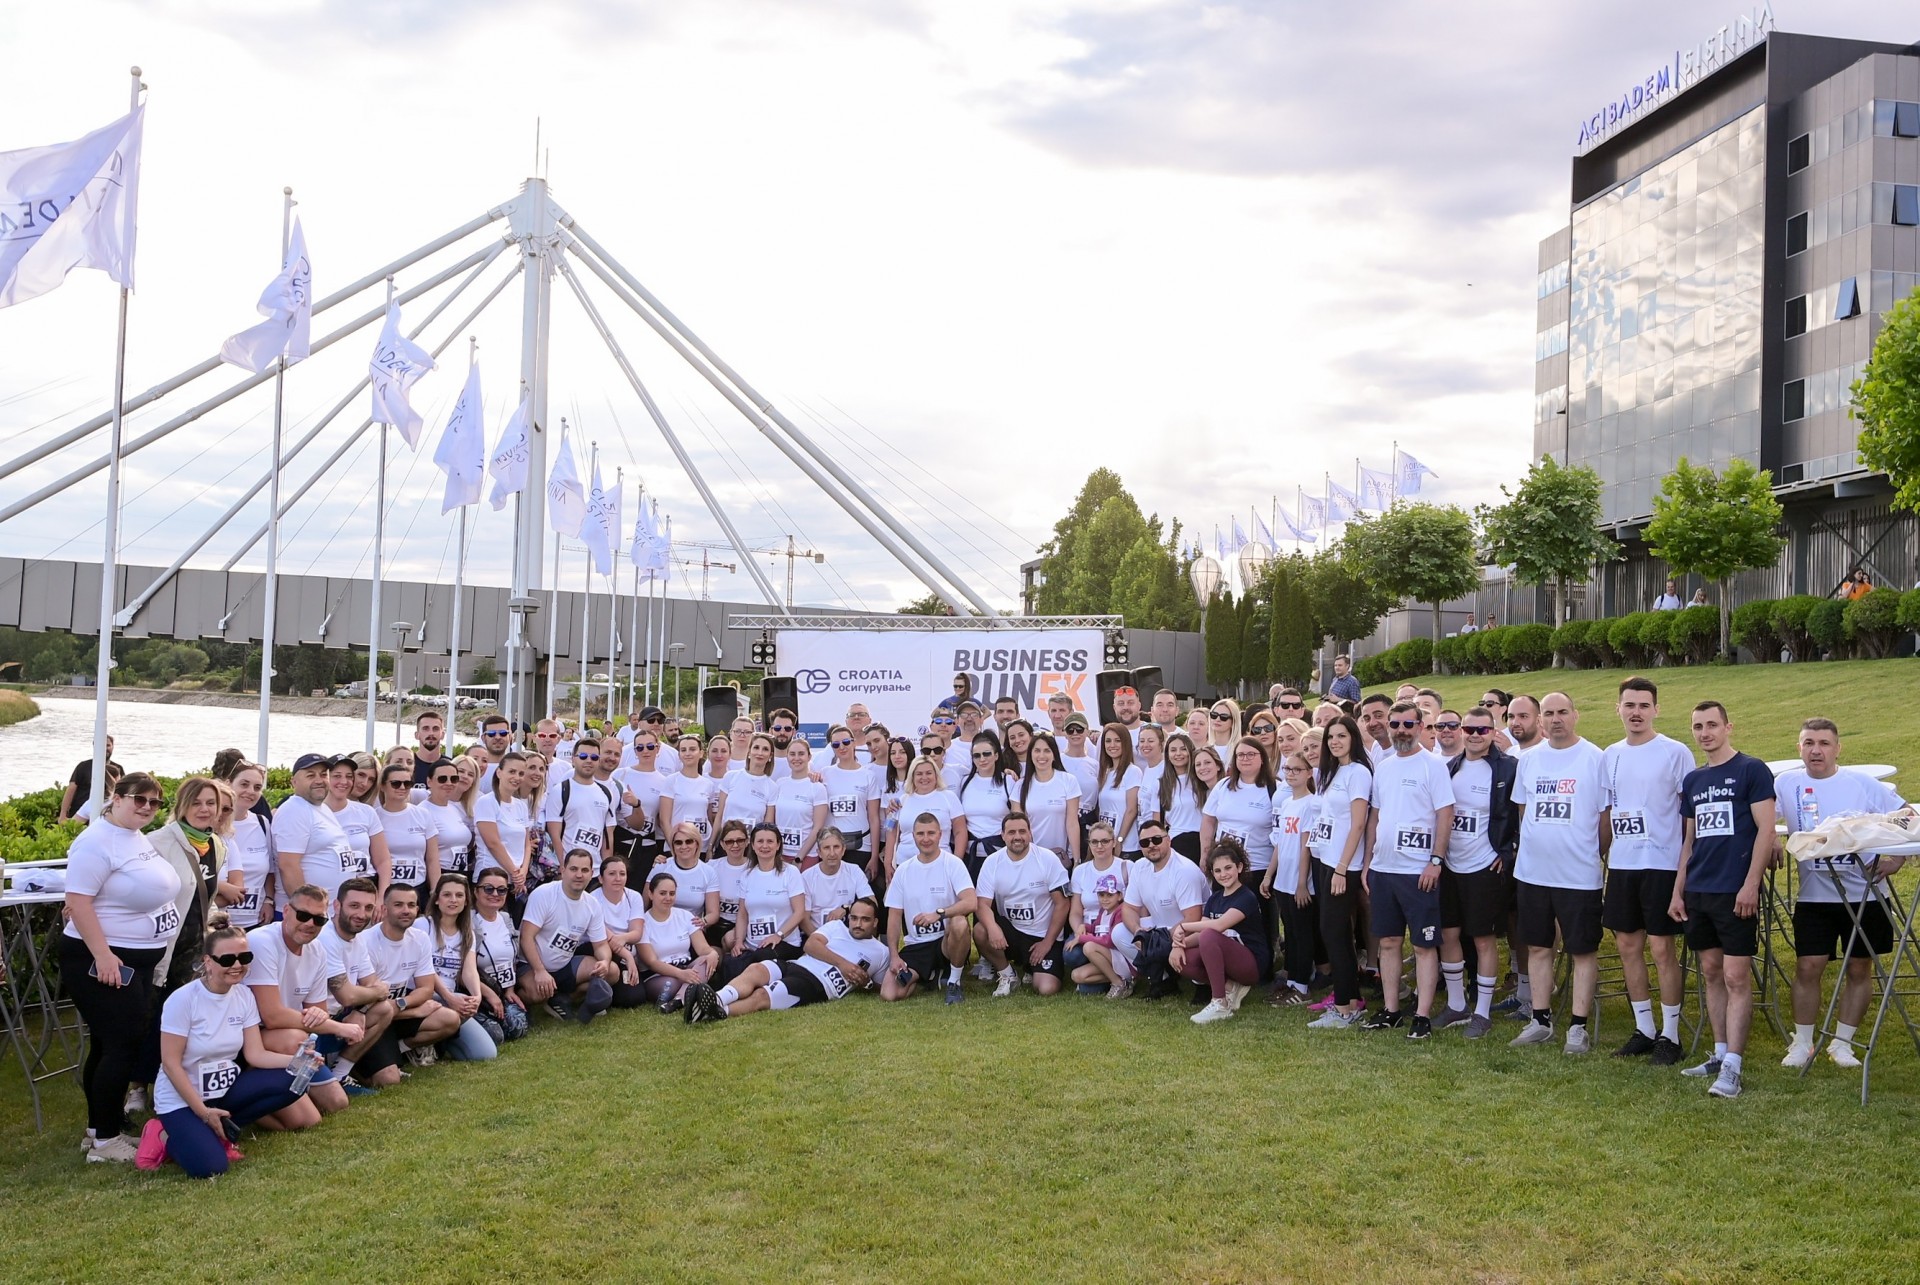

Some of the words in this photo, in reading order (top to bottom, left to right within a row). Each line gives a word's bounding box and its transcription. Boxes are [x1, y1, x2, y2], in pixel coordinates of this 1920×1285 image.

[1578, 64, 1671, 146] ACIBADEM
[1683, 0, 1774, 76] SISTINA
[953, 649, 1088, 672] BUSINESS
[838, 670, 903, 680] CROATIA
[838, 683, 912, 694] осигурување
[1536, 784, 1557, 794] RUN
[1558, 779, 1576, 794] 5K
[832, 800, 854, 812] 535
[1538, 803, 1567, 818] 219
[1284, 816, 1300, 834] 5K
[1614, 819, 1641, 834] 225
[1698, 812, 1726, 830] 226
[578, 830, 599, 847] 543
[1401, 832, 1427, 848] 541
[158, 910, 178, 932] 665
[1010, 908, 1031, 920] 640
[751, 922, 772, 935] 551
[555, 935, 577, 952] 562
[827, 971, 845, 993] 666
[208, 1069, 237, 1091] 655
